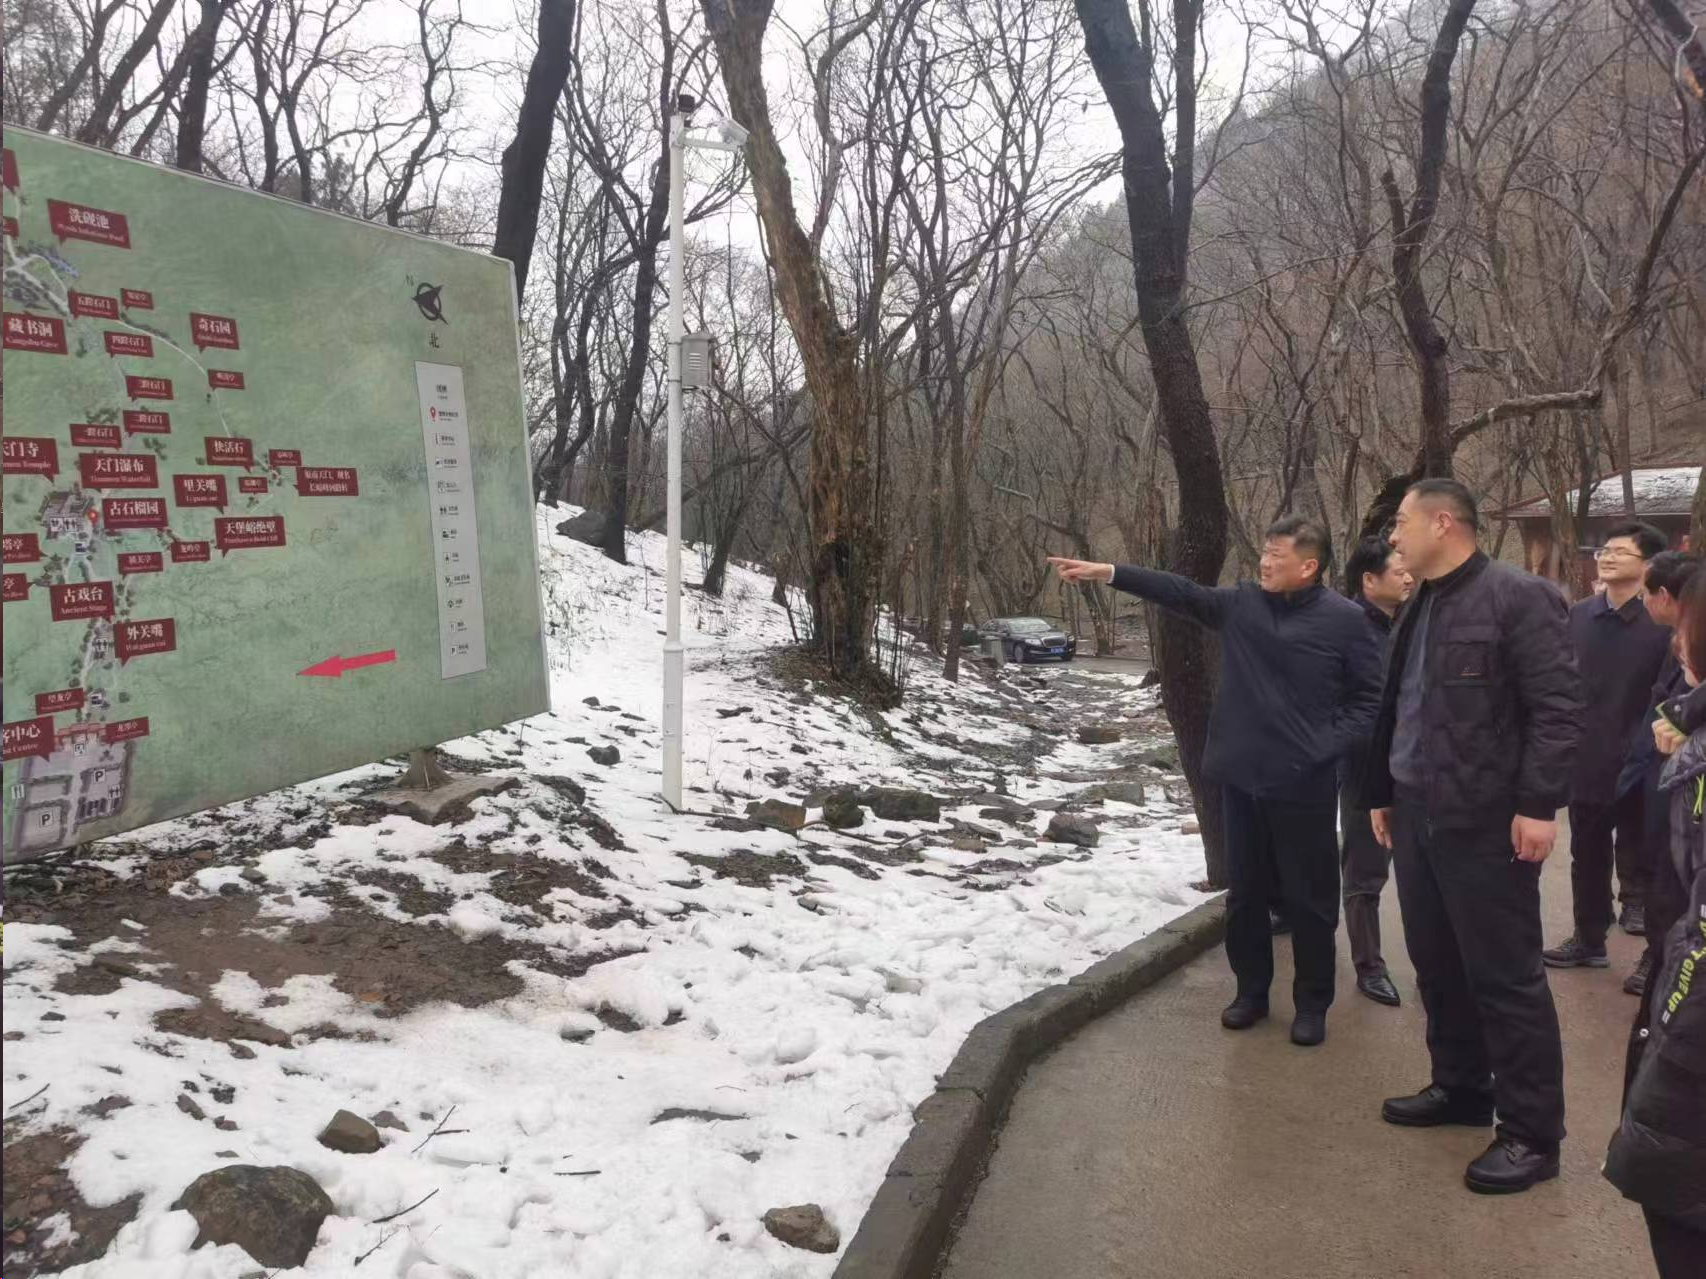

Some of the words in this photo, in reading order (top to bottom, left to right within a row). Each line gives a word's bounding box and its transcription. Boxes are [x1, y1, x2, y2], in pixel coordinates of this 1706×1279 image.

[8, 317, 53, 337] 藏书洞
[94, 458, 144, 473] 天门瀑布
[110, 501, 159, 516] 古石榴园
[64, 586, 104, 604] 古戏台
[60, 606, 86, 615] Ancient
[127, 624, 164, 641] 外关嘴
[95, 770, 104, 782] P
[42, 814, 50, 826] P
[1679, 958, 1695, 995] GIVE
[1667, 991, 1683, 1012] UP
